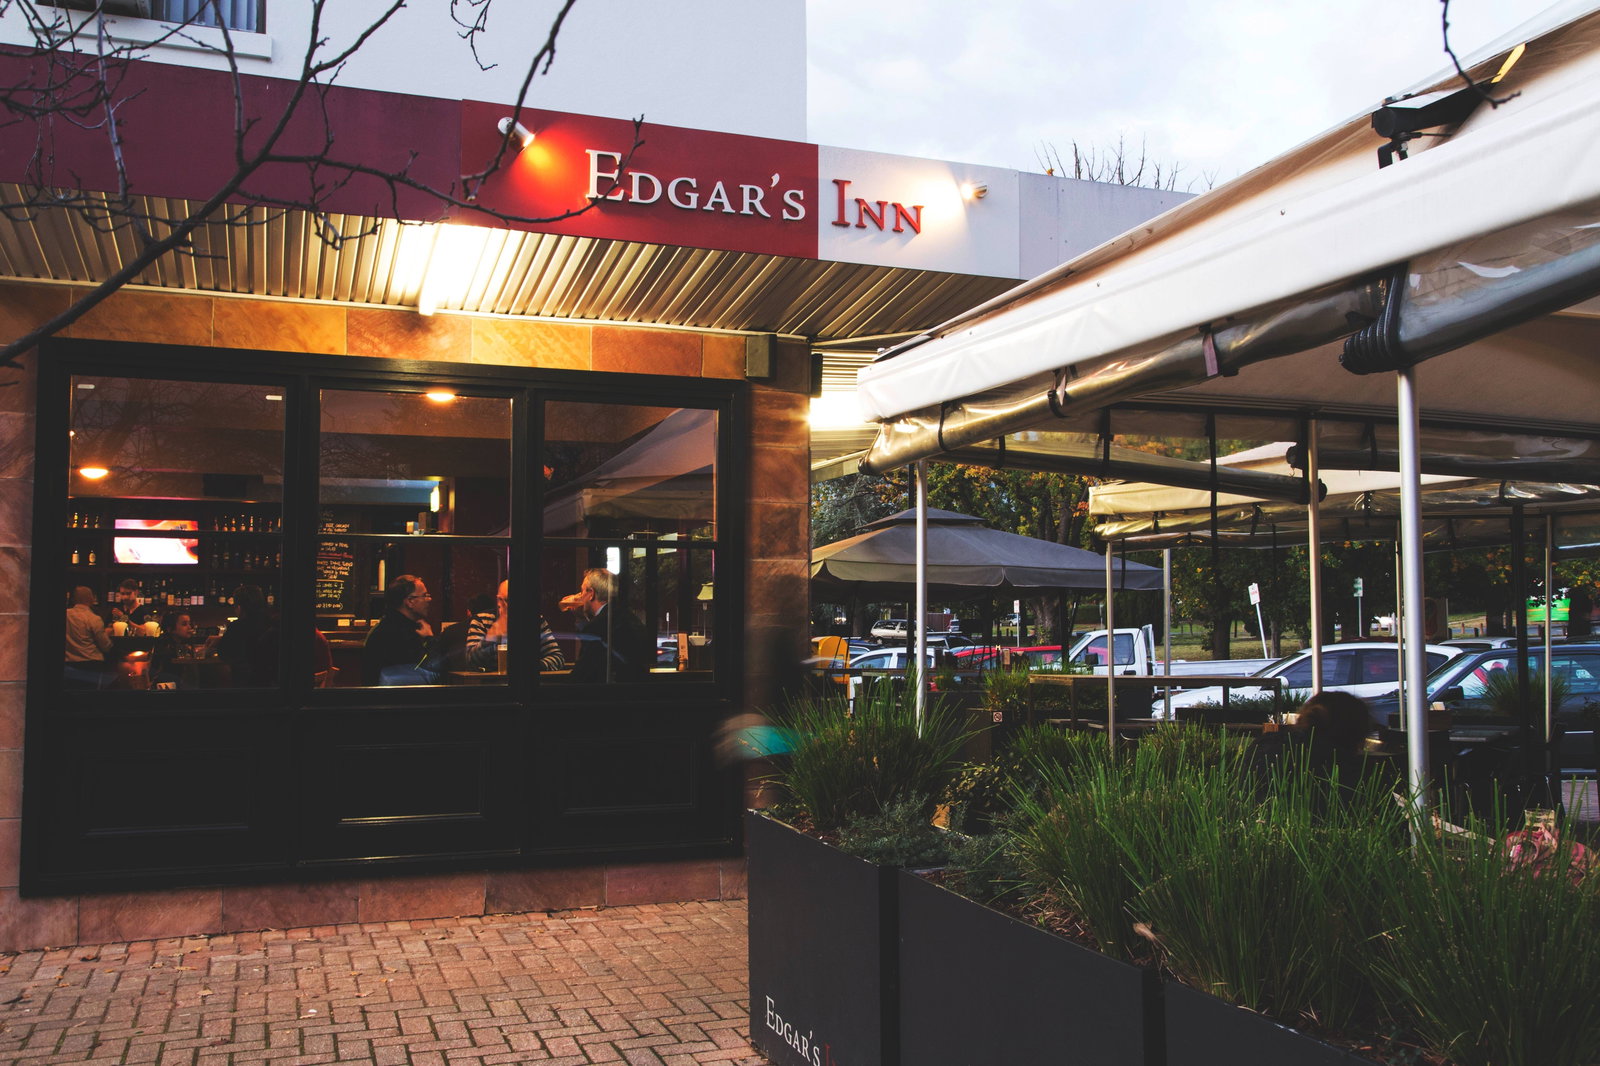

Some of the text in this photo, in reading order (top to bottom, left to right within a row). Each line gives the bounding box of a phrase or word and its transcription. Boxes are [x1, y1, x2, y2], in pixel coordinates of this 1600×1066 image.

[585, 149, 924, 235] EDGAR'S INN
[766, 995, 821, 1066] EDGAR'S
